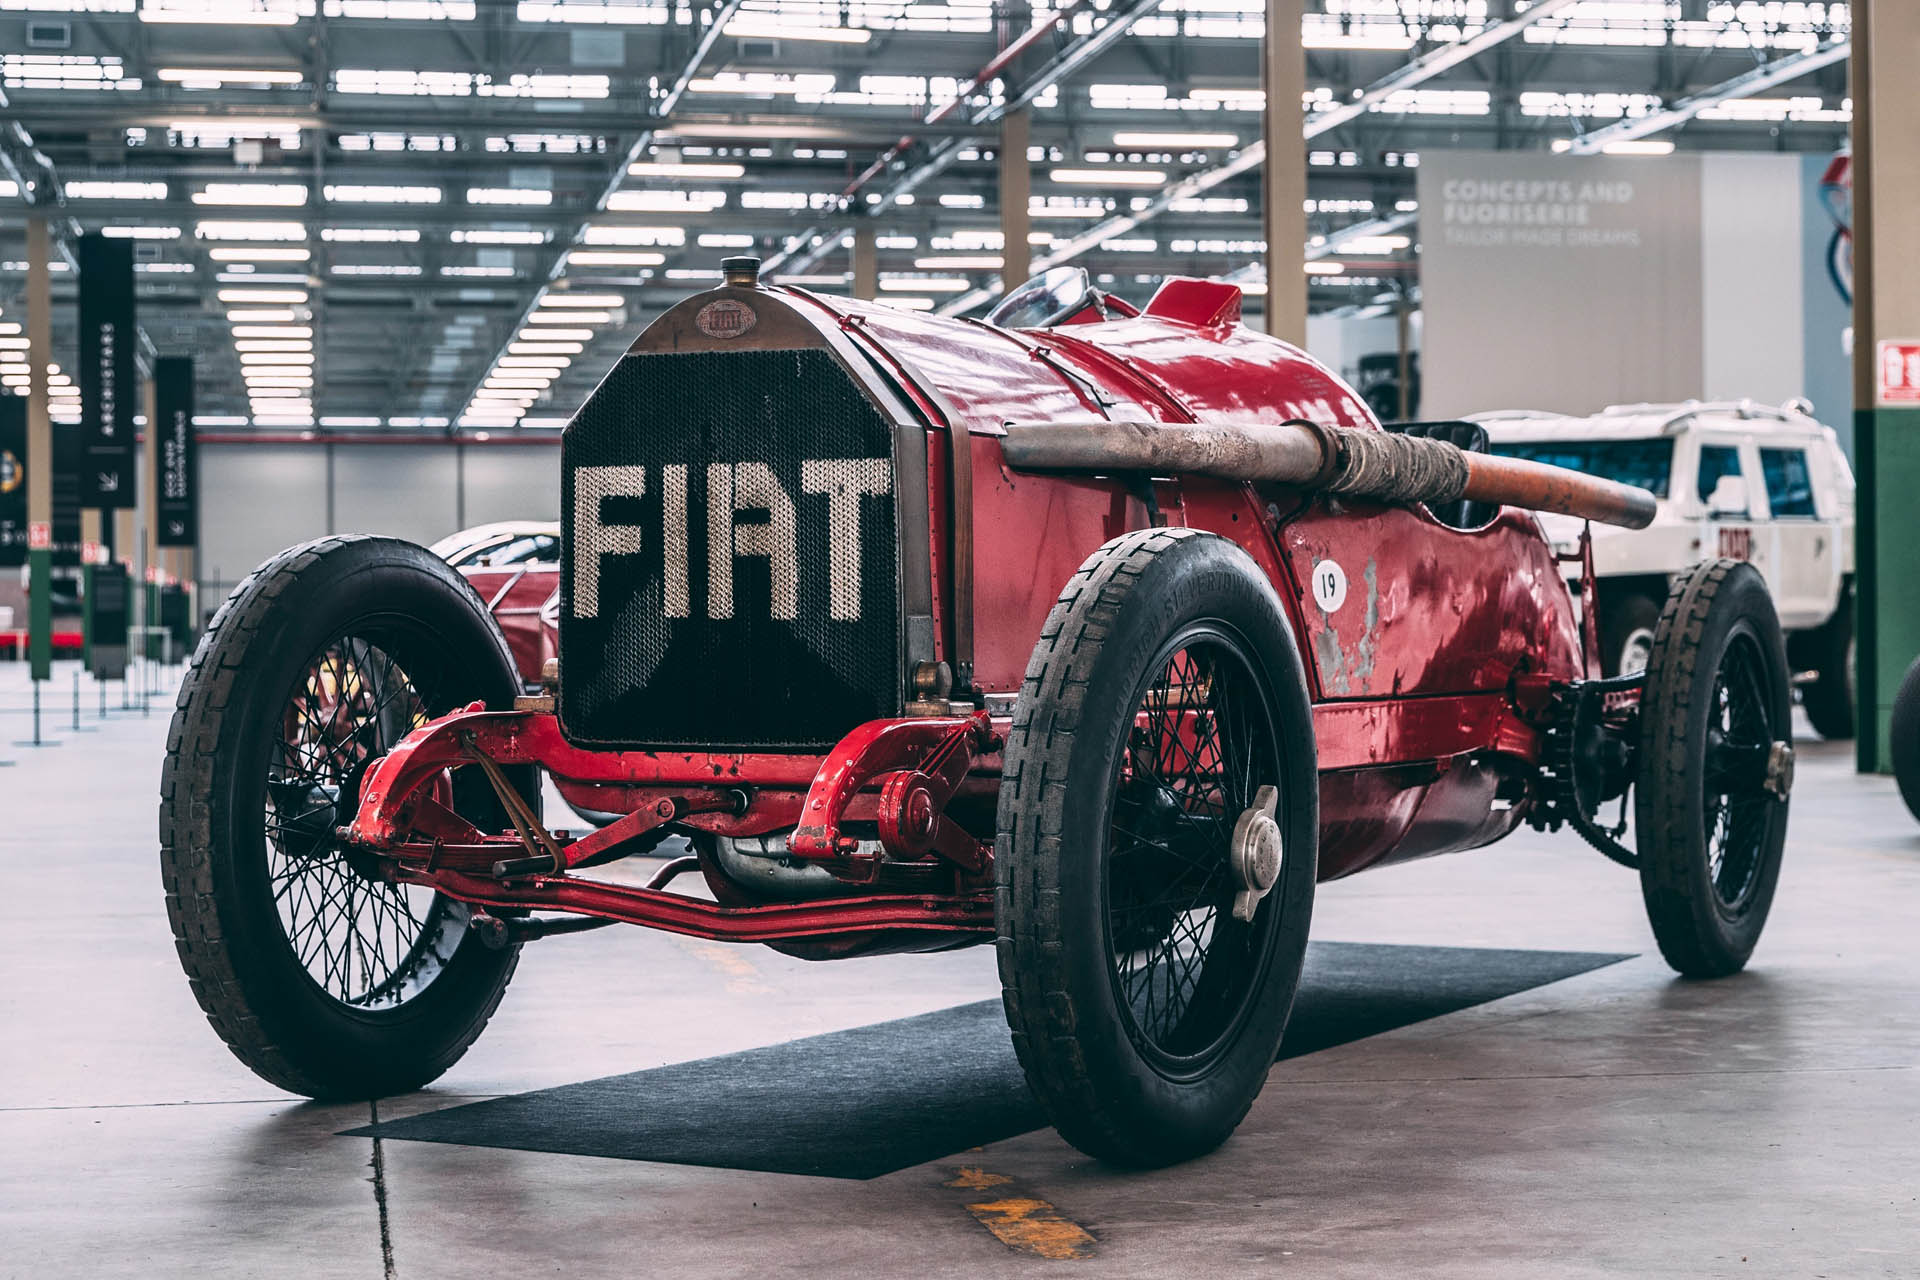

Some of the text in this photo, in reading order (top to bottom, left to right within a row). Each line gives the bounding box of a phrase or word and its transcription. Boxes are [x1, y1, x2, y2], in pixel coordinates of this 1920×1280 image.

[1442, 180, 1634, 202] CONCEPTS AND
[1443, 204, 1589, 224] FUORISERIE
[101, 323, 115, 437] ARCHISTARS
[573, 458, 892, 621] FIAT
[1322, 573, 1336, 599] 19
